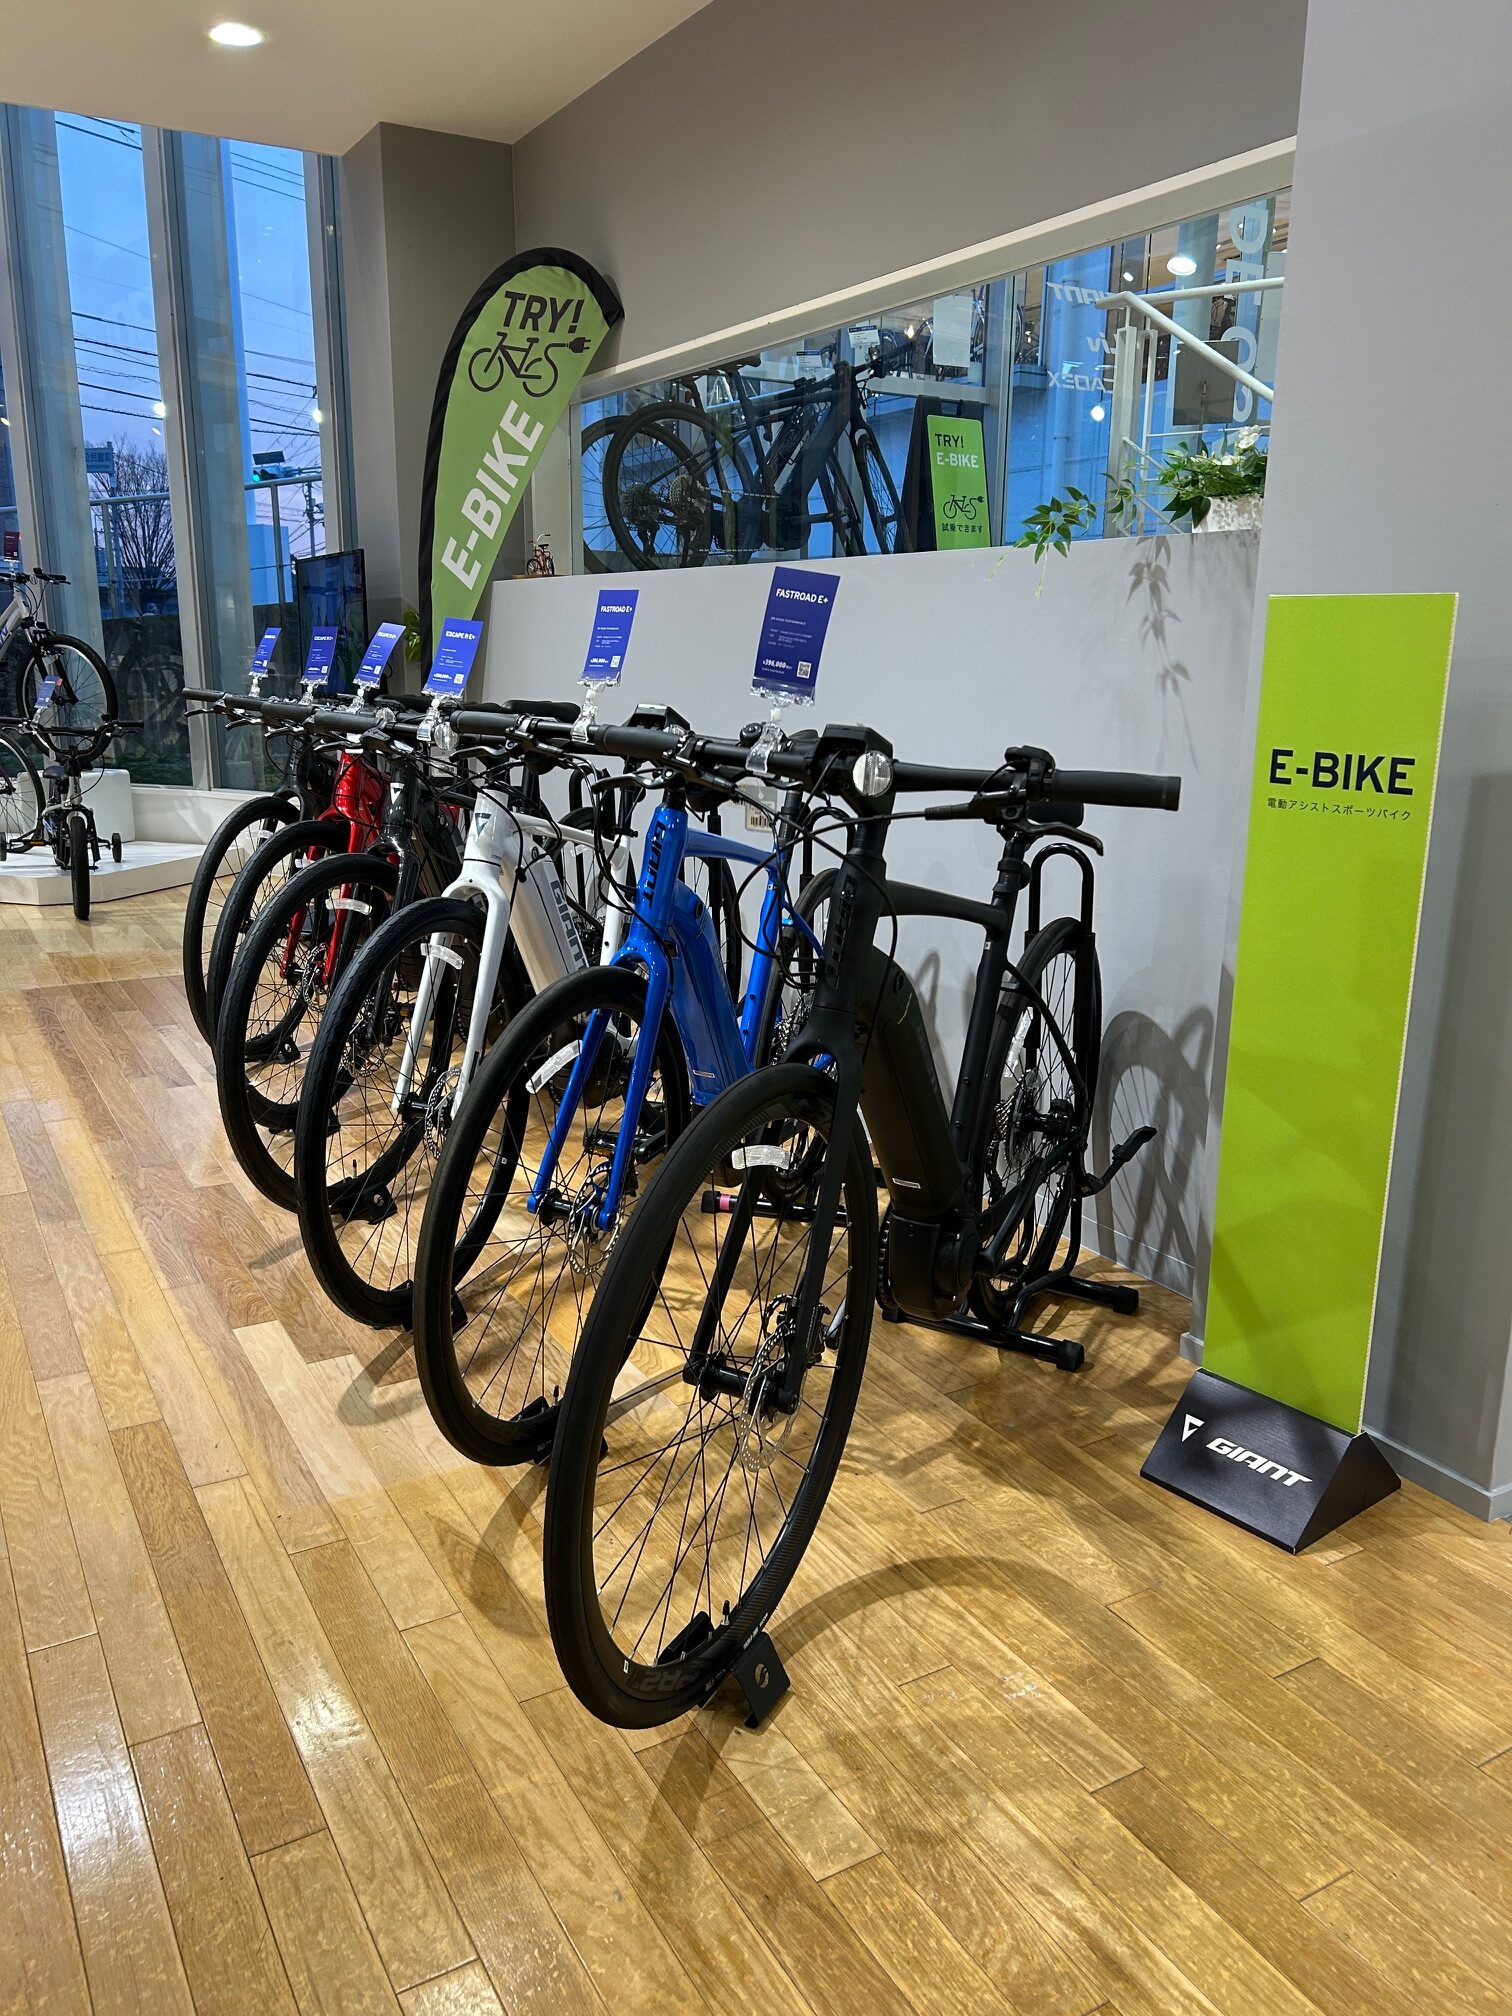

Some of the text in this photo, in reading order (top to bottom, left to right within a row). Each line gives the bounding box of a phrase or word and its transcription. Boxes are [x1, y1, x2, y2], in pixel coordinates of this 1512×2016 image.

[503, 290, 585, 334] TRY!
[934, 433, 964, 448] TRY!
[936, 451, 979, 468] E-BIKE
[440, 399, 545, 591] E-BIKE
[941, 522, 983, 533] 試乗できます
[775, 588, 829, 604] FASTROAD E+
[600, 605, 625, 613] FASTROAD
[1269, 748, 1416, 795] E-BIKE
[1267, 797, 1411, 821] 電動アシストスポーツバイク
[550, 880, 585, 969] GIAN
[1205, 1436, 1313, 1487] GIANT
